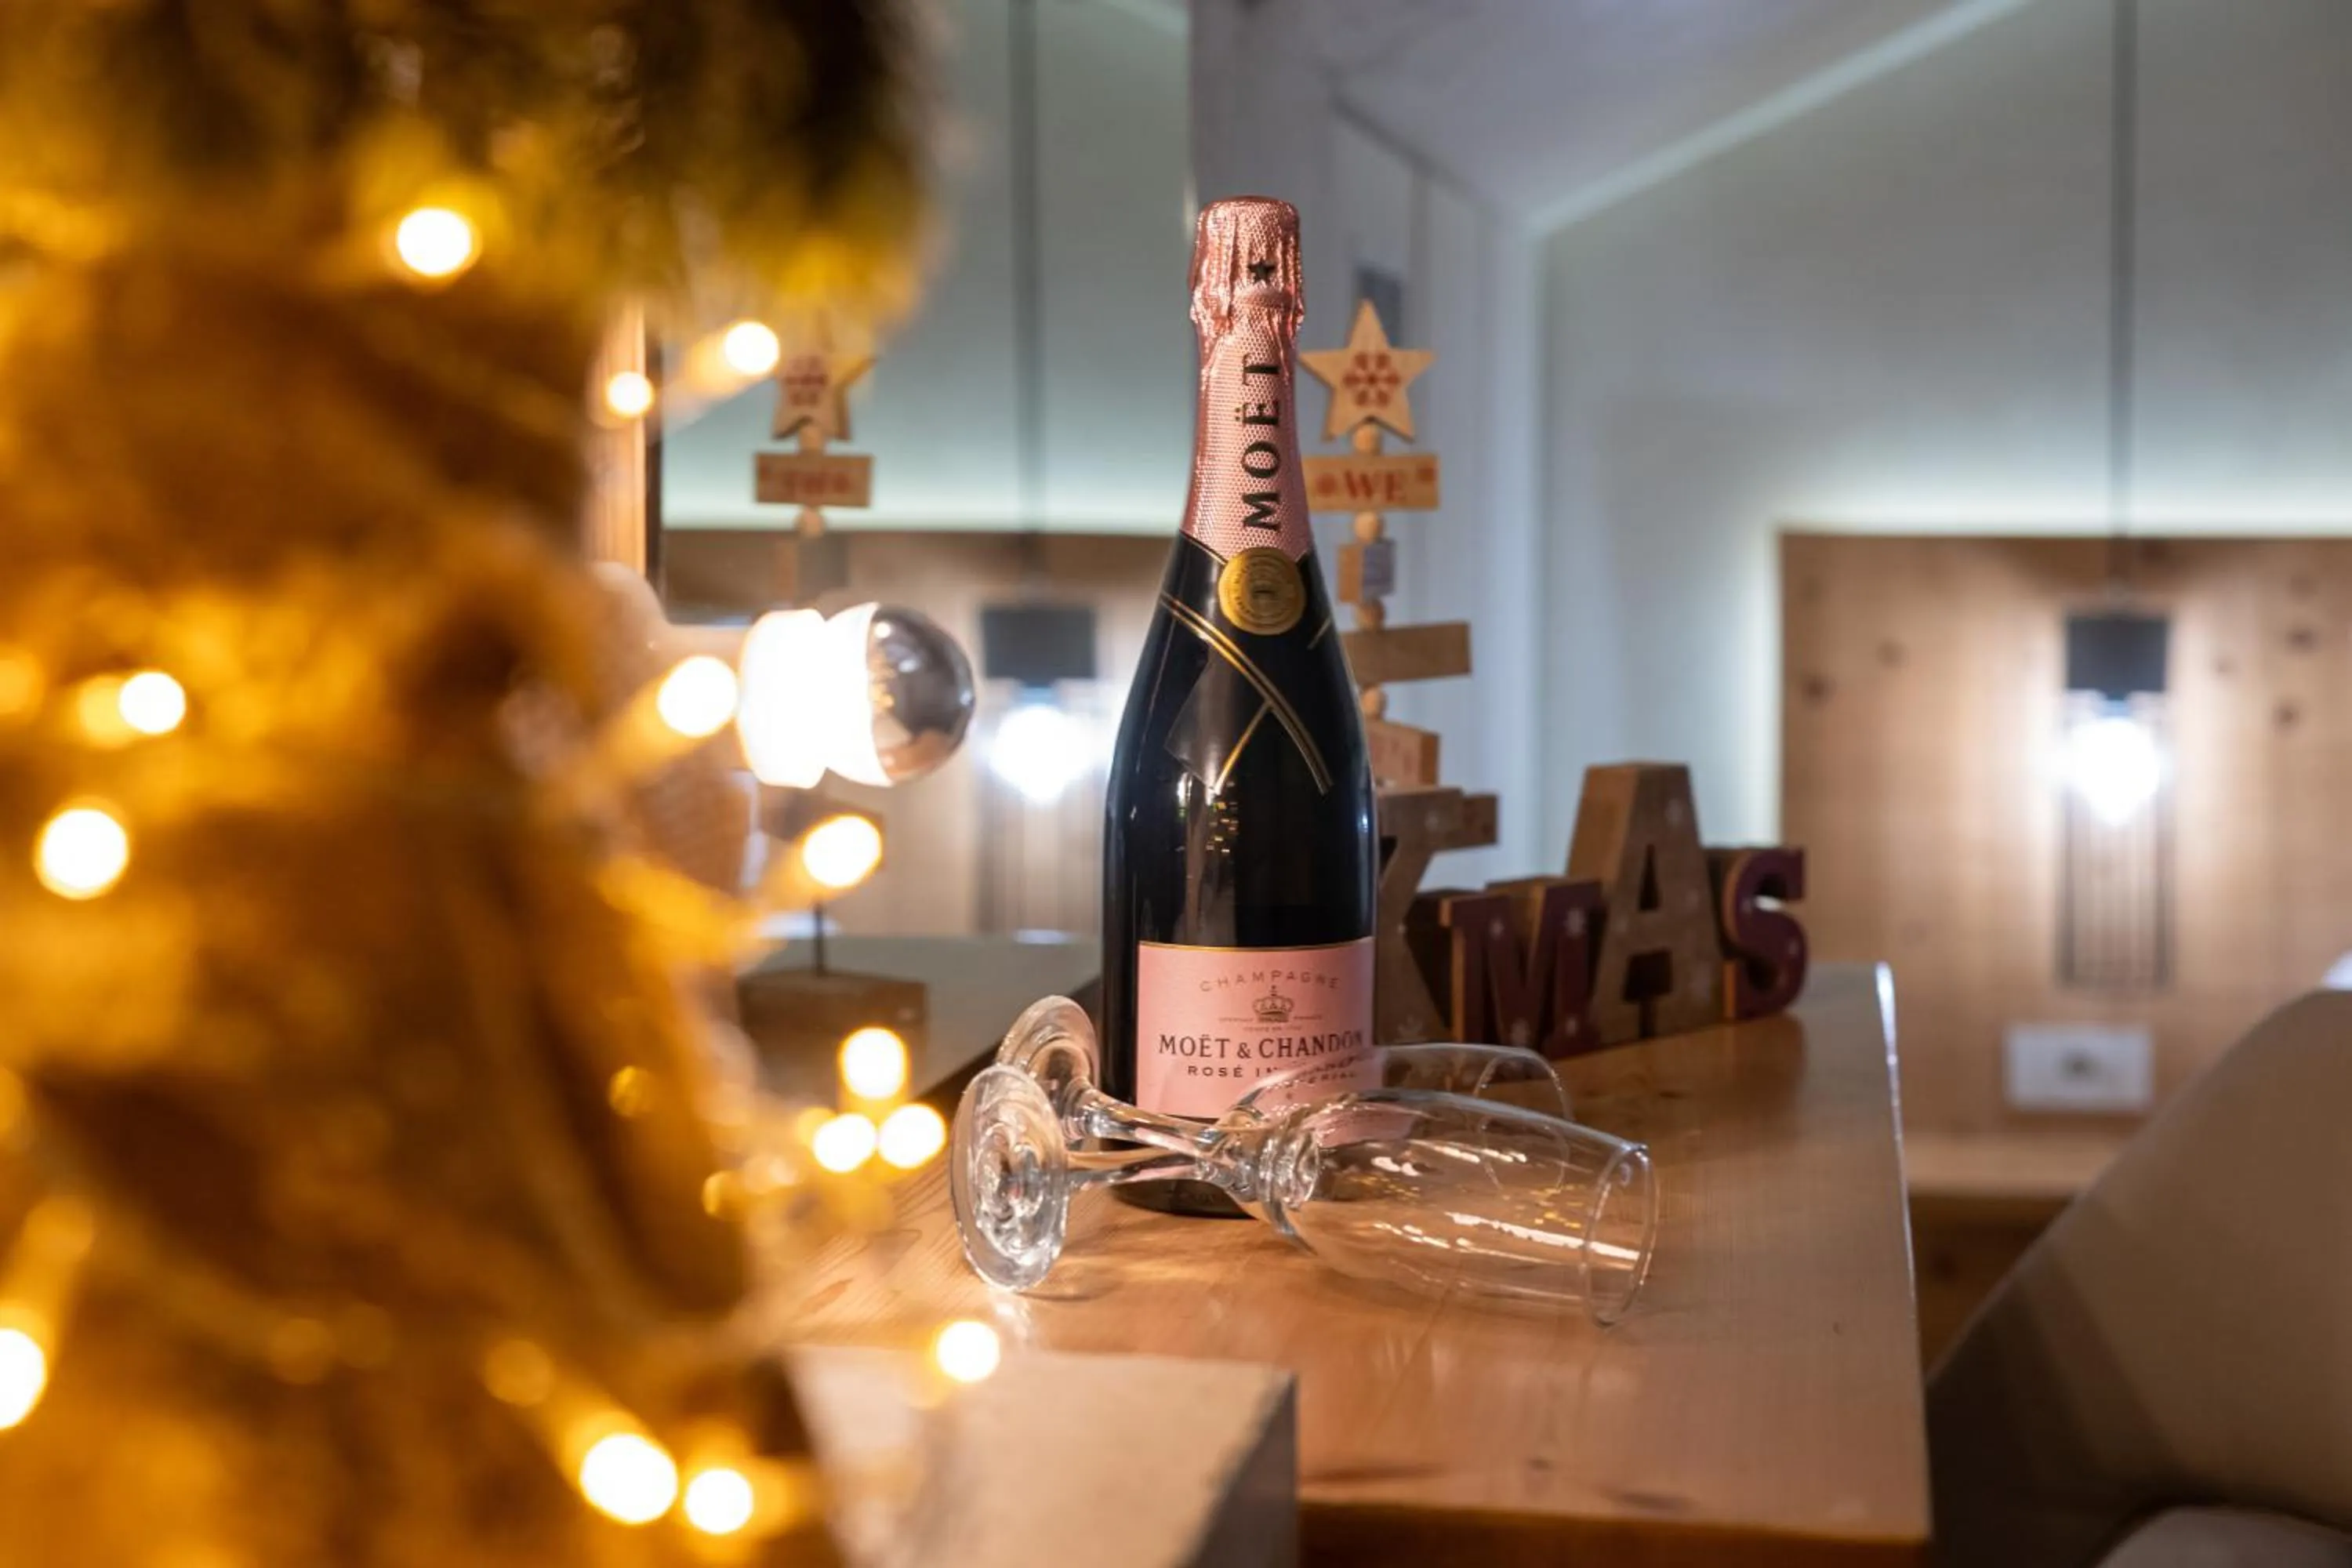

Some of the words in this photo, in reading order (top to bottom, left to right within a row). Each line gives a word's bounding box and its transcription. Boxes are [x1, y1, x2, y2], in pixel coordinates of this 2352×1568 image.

[1236, 353, 1280, 531] MOËT
[1200, 969, 1340, 993] CHAMPAGNE
[1159, 1033, 1231, 1059] MOËT
[1236, 1041, 1252, 1059] &
[1258, 1029, 1364, 1060] CHANDON
[1187, 1064, 1243, 1078] ROSÉ
